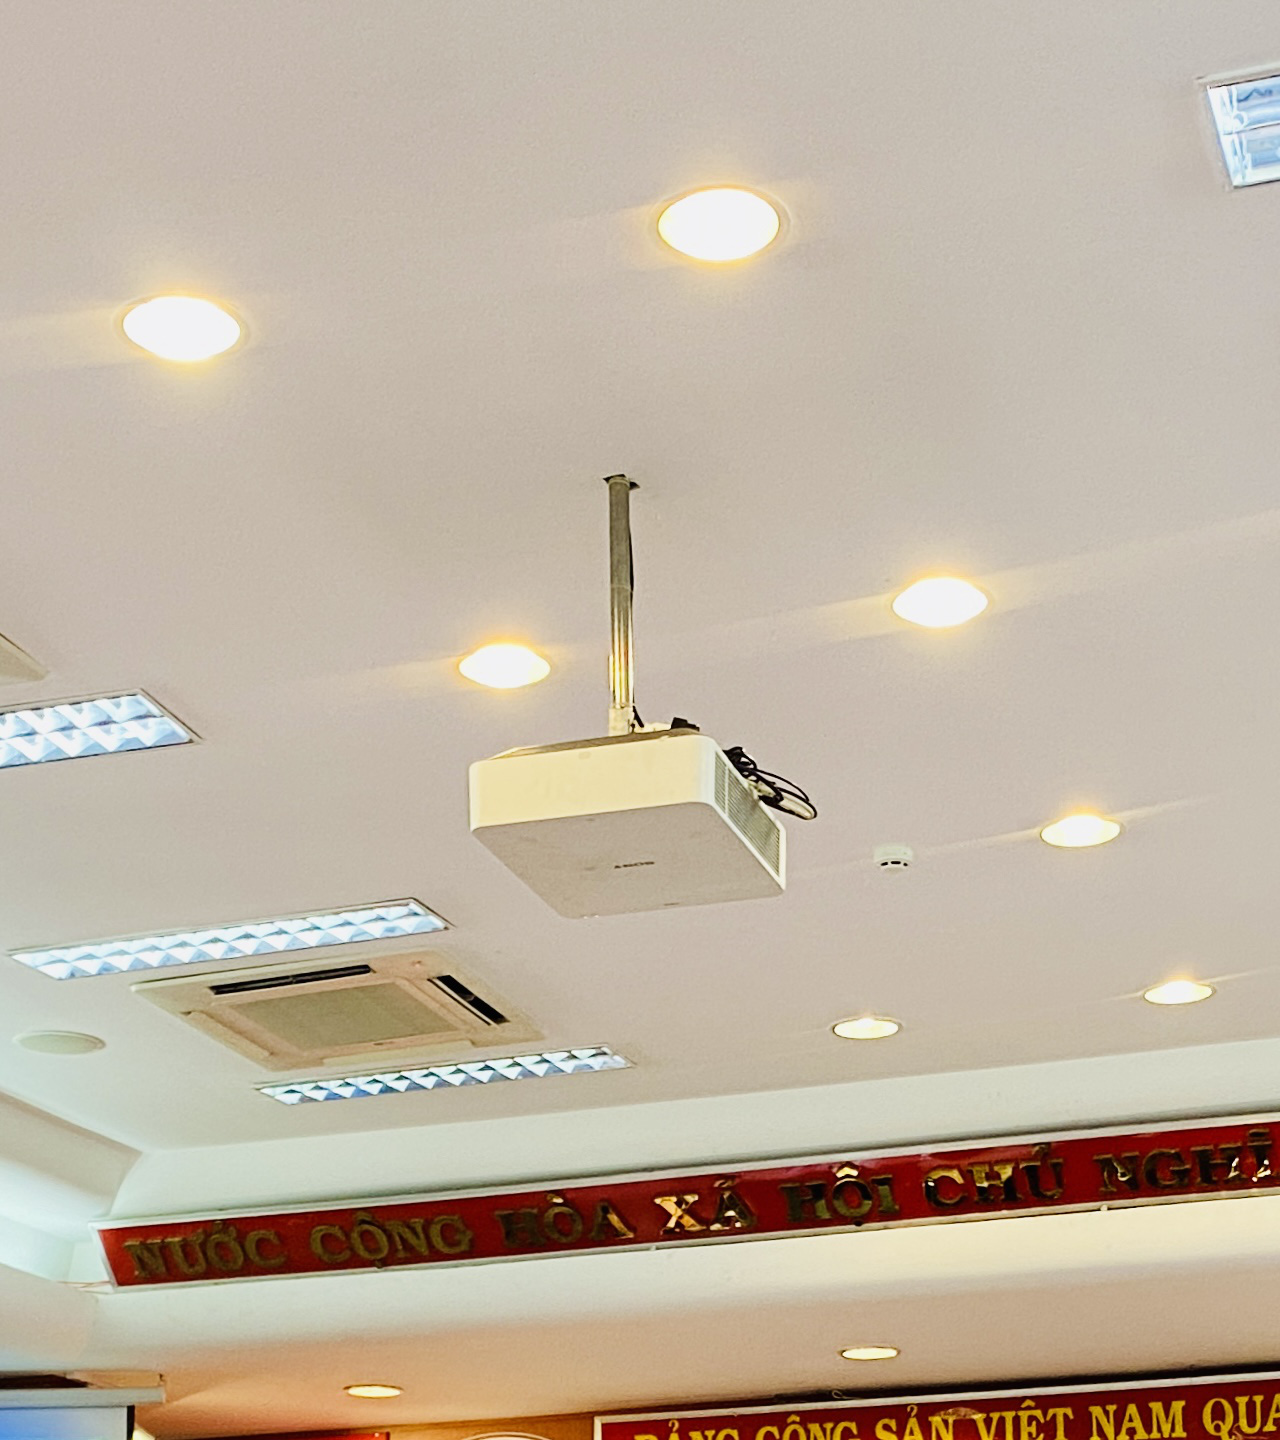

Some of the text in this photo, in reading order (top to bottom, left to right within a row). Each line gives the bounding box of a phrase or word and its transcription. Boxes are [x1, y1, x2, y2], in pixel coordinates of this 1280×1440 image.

[124, 1220, 287, 1279] NƯỚC
[310, 1211, 474, 1269] CỘNG
[495, 1193, 634, 1246] HÒA
[654, 1178, 758, 1234] XÃ
[780, 1161, 900, 1227] HỘI
[923, 1142, 1064, 1207] CHỦ
